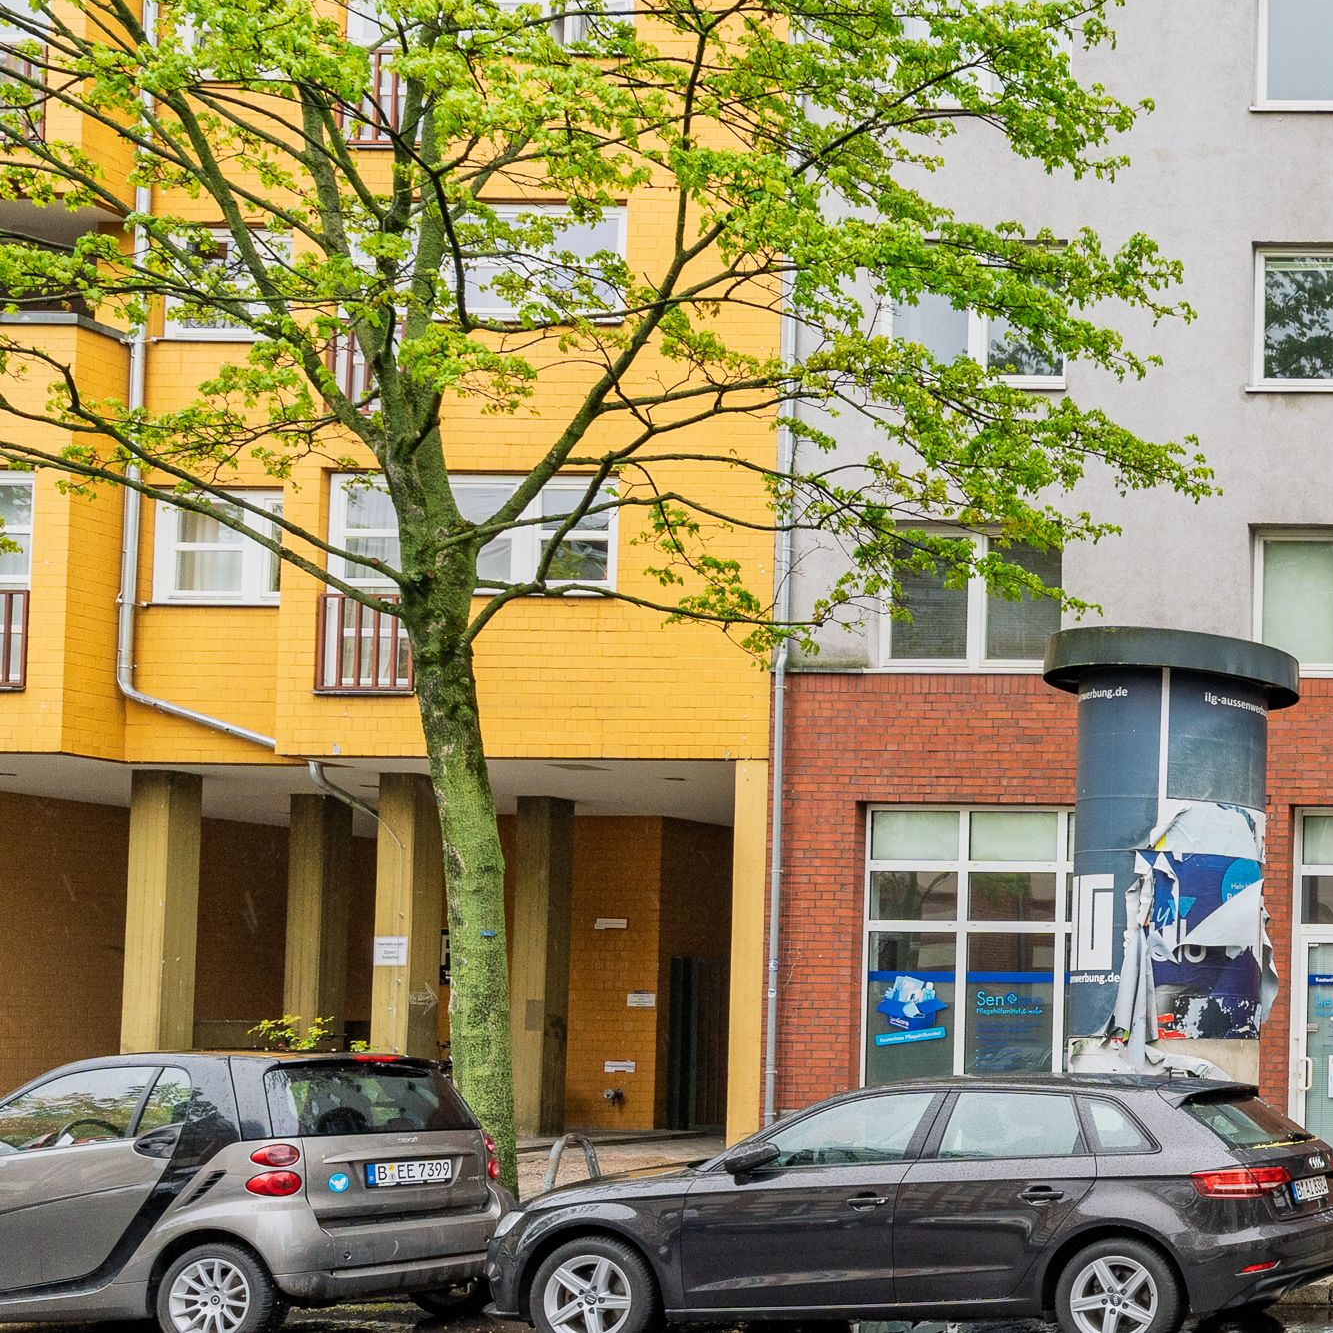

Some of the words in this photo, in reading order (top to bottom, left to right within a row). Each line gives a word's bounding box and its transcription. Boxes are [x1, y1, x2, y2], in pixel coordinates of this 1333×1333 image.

[378, 1166, 388, 1180] B
[398, 1164, 415, 1179] EE
[418, 1161, 450, 1177] 7399
